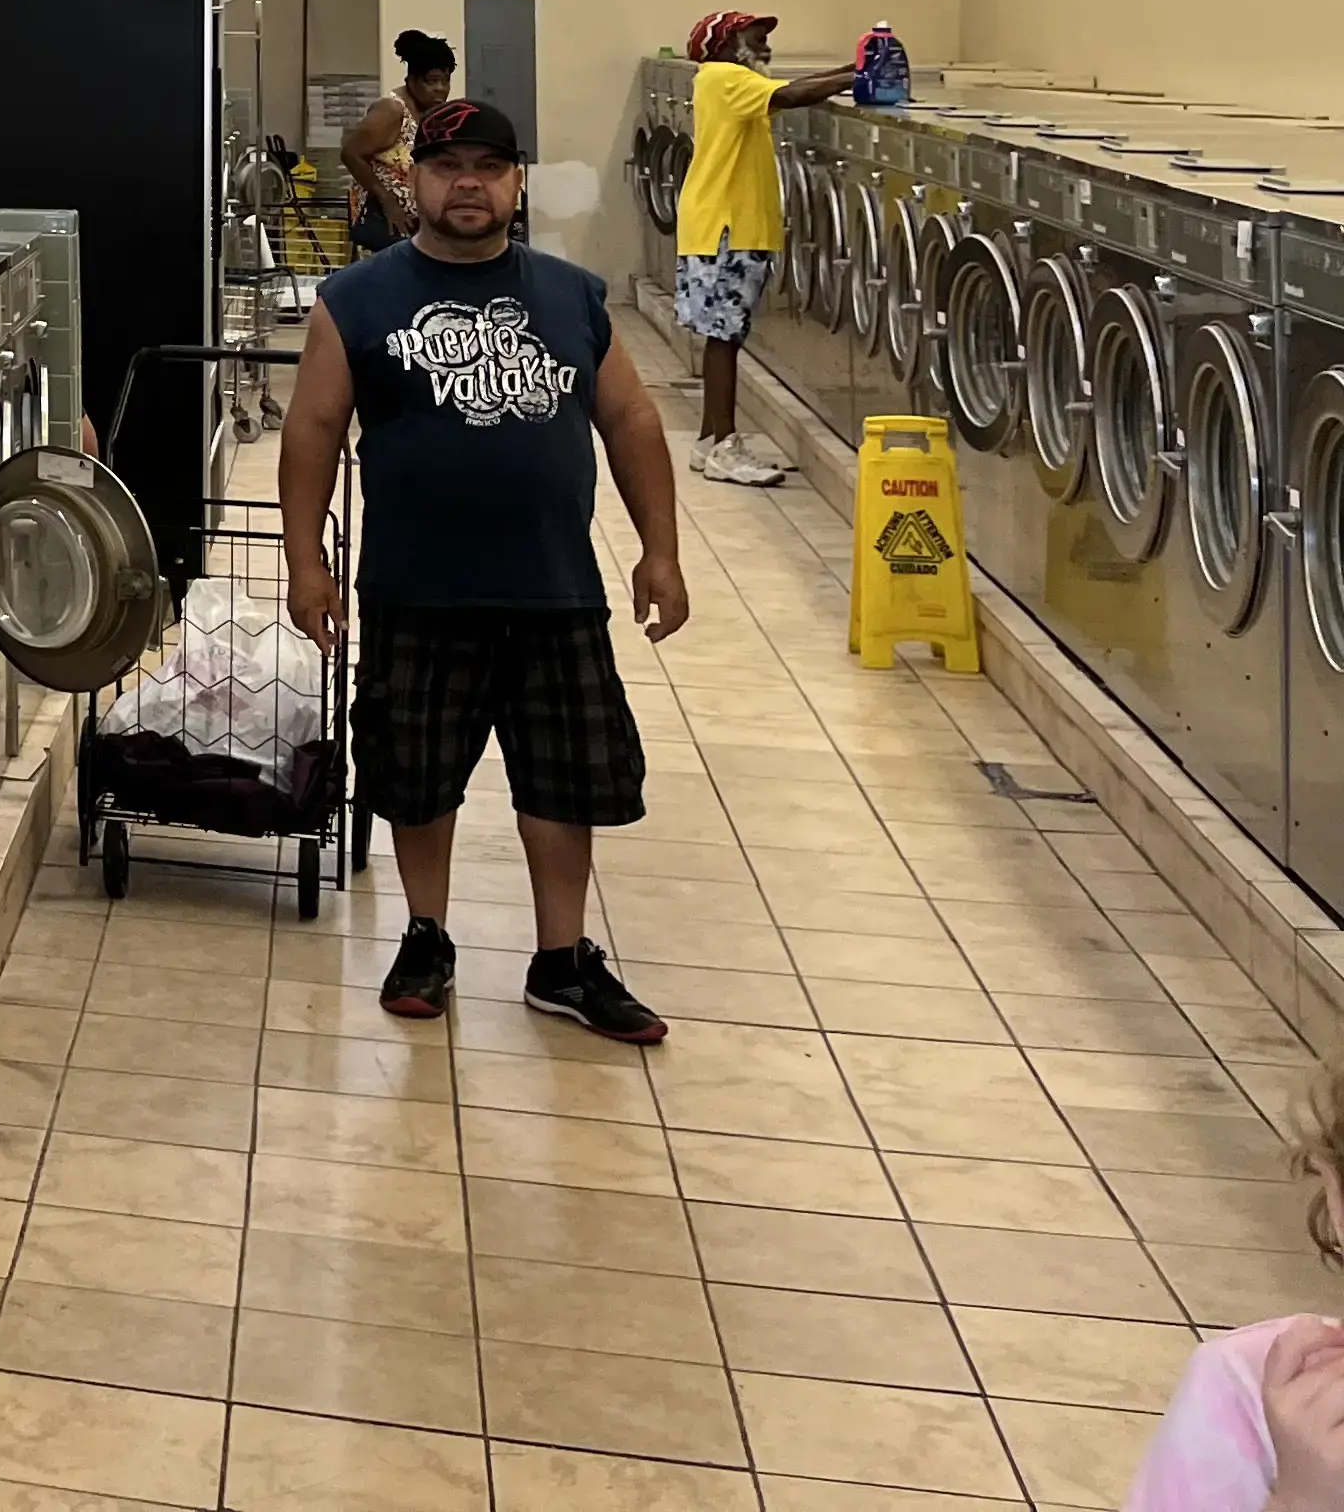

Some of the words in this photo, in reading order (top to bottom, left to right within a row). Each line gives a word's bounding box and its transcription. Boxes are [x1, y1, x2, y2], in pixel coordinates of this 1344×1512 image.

[881, 479, 939, 497] CAUTION
[915, 509, 955, 560] ATTENTION
[889, 562, 938, 576] CUIDADO
